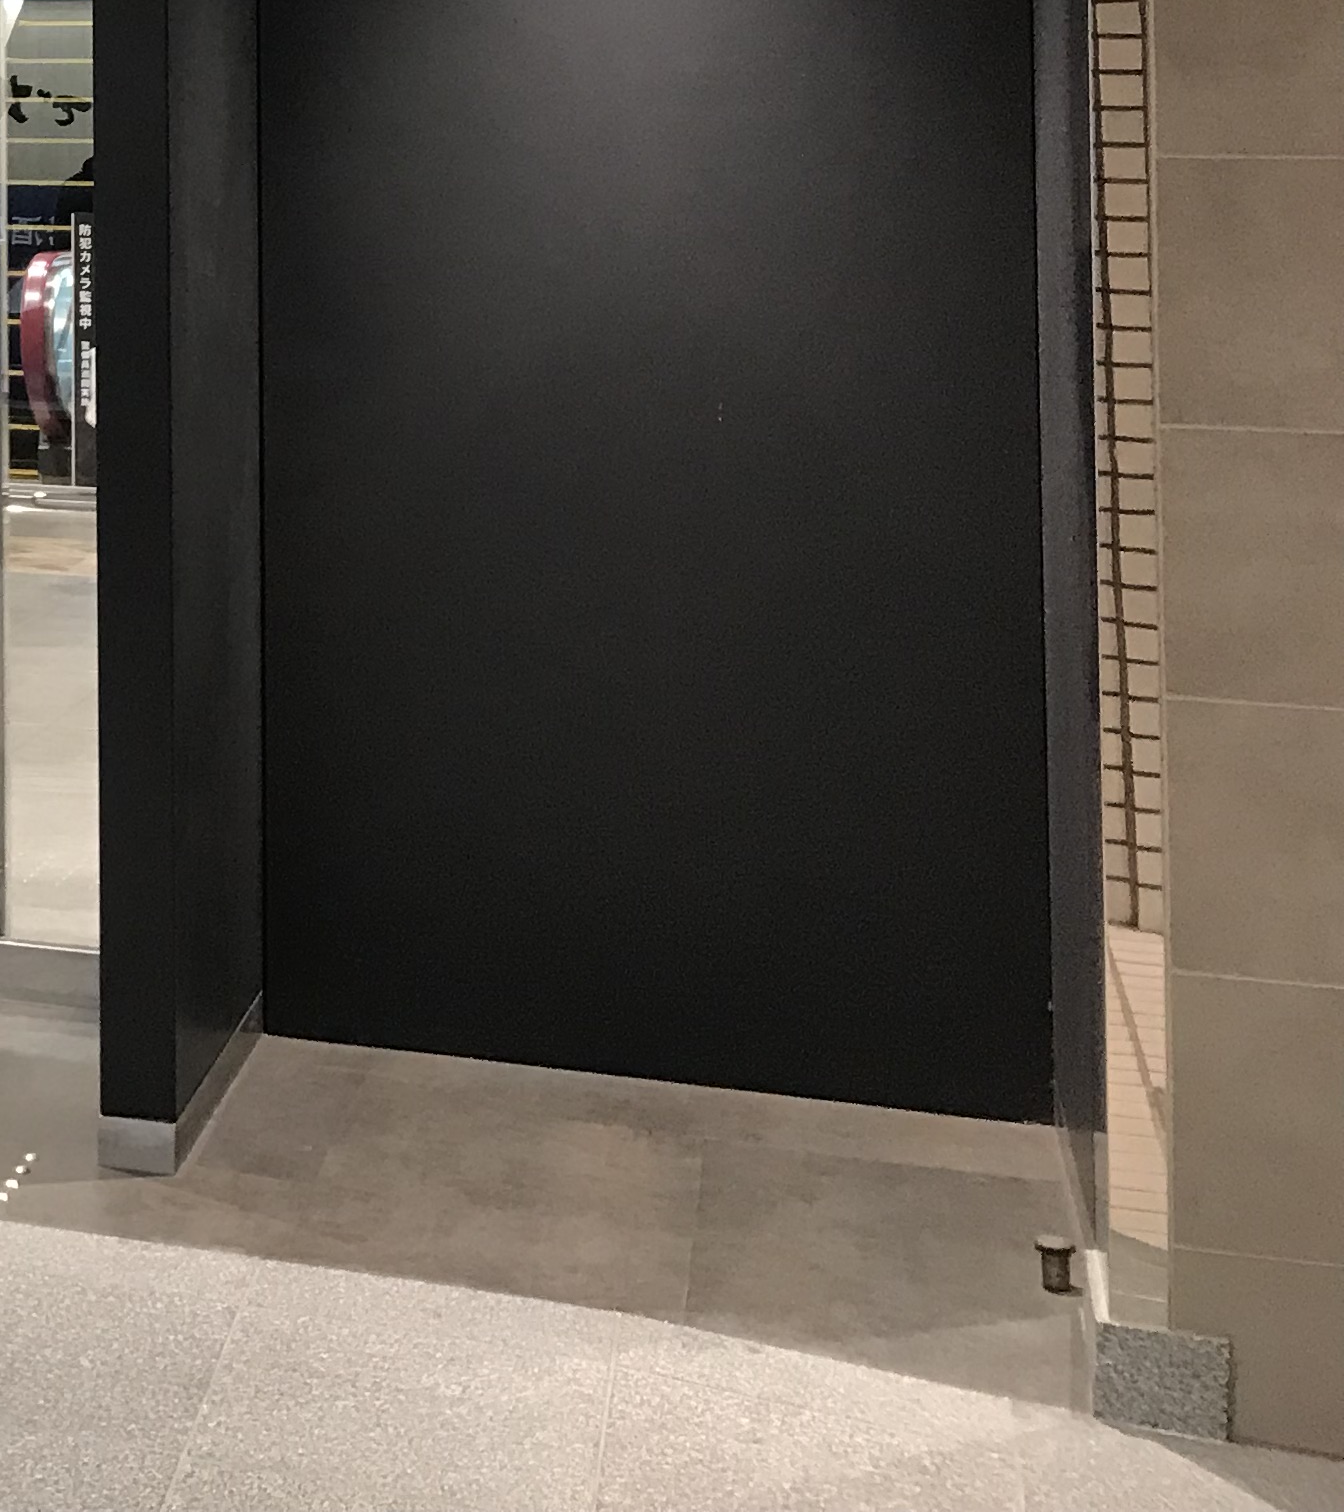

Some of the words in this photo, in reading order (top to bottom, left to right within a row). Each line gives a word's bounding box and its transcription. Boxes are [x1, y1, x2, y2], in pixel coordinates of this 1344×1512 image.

[78, 223, 93, 330] 防犯カメラ監視中
